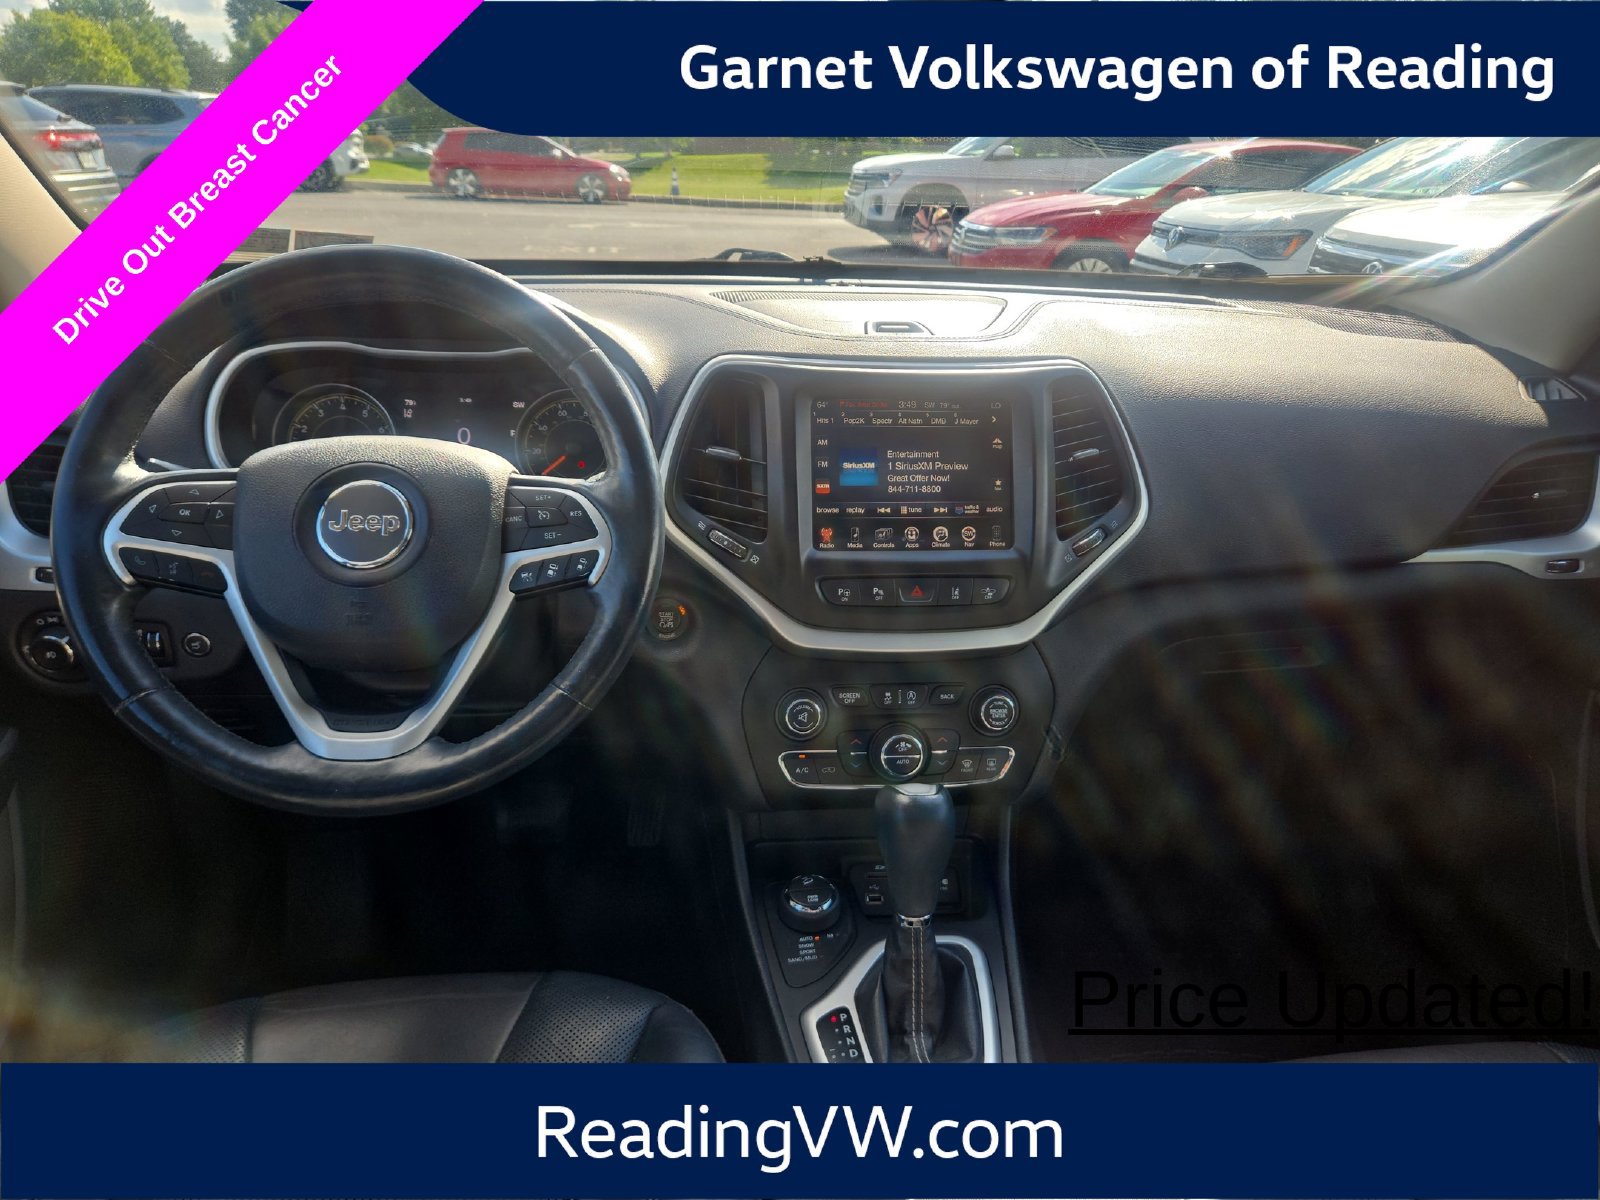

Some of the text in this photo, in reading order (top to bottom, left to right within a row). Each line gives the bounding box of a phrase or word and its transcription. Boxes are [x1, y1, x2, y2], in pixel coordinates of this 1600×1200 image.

[898, 400, 917, 409] 3:49
[457, 427, 471, 445] 0
[887, 450, 940, 459] Entertainment
[888, 462, 969, 471] 1 SiriusXM Preview
[887, 474, 950, 482] Great Offer Now!
[887, 485, 941, 493] 844-711-8800
[179, 508, 191, 516] OK
[328, 509, 400, 536] Jeep
[840, 1013, 847, 1022] P
[843, 1024, 852, 1034] R
[846, 1036, 856, 1046] N
[849, 1048, 859, 1058] D
